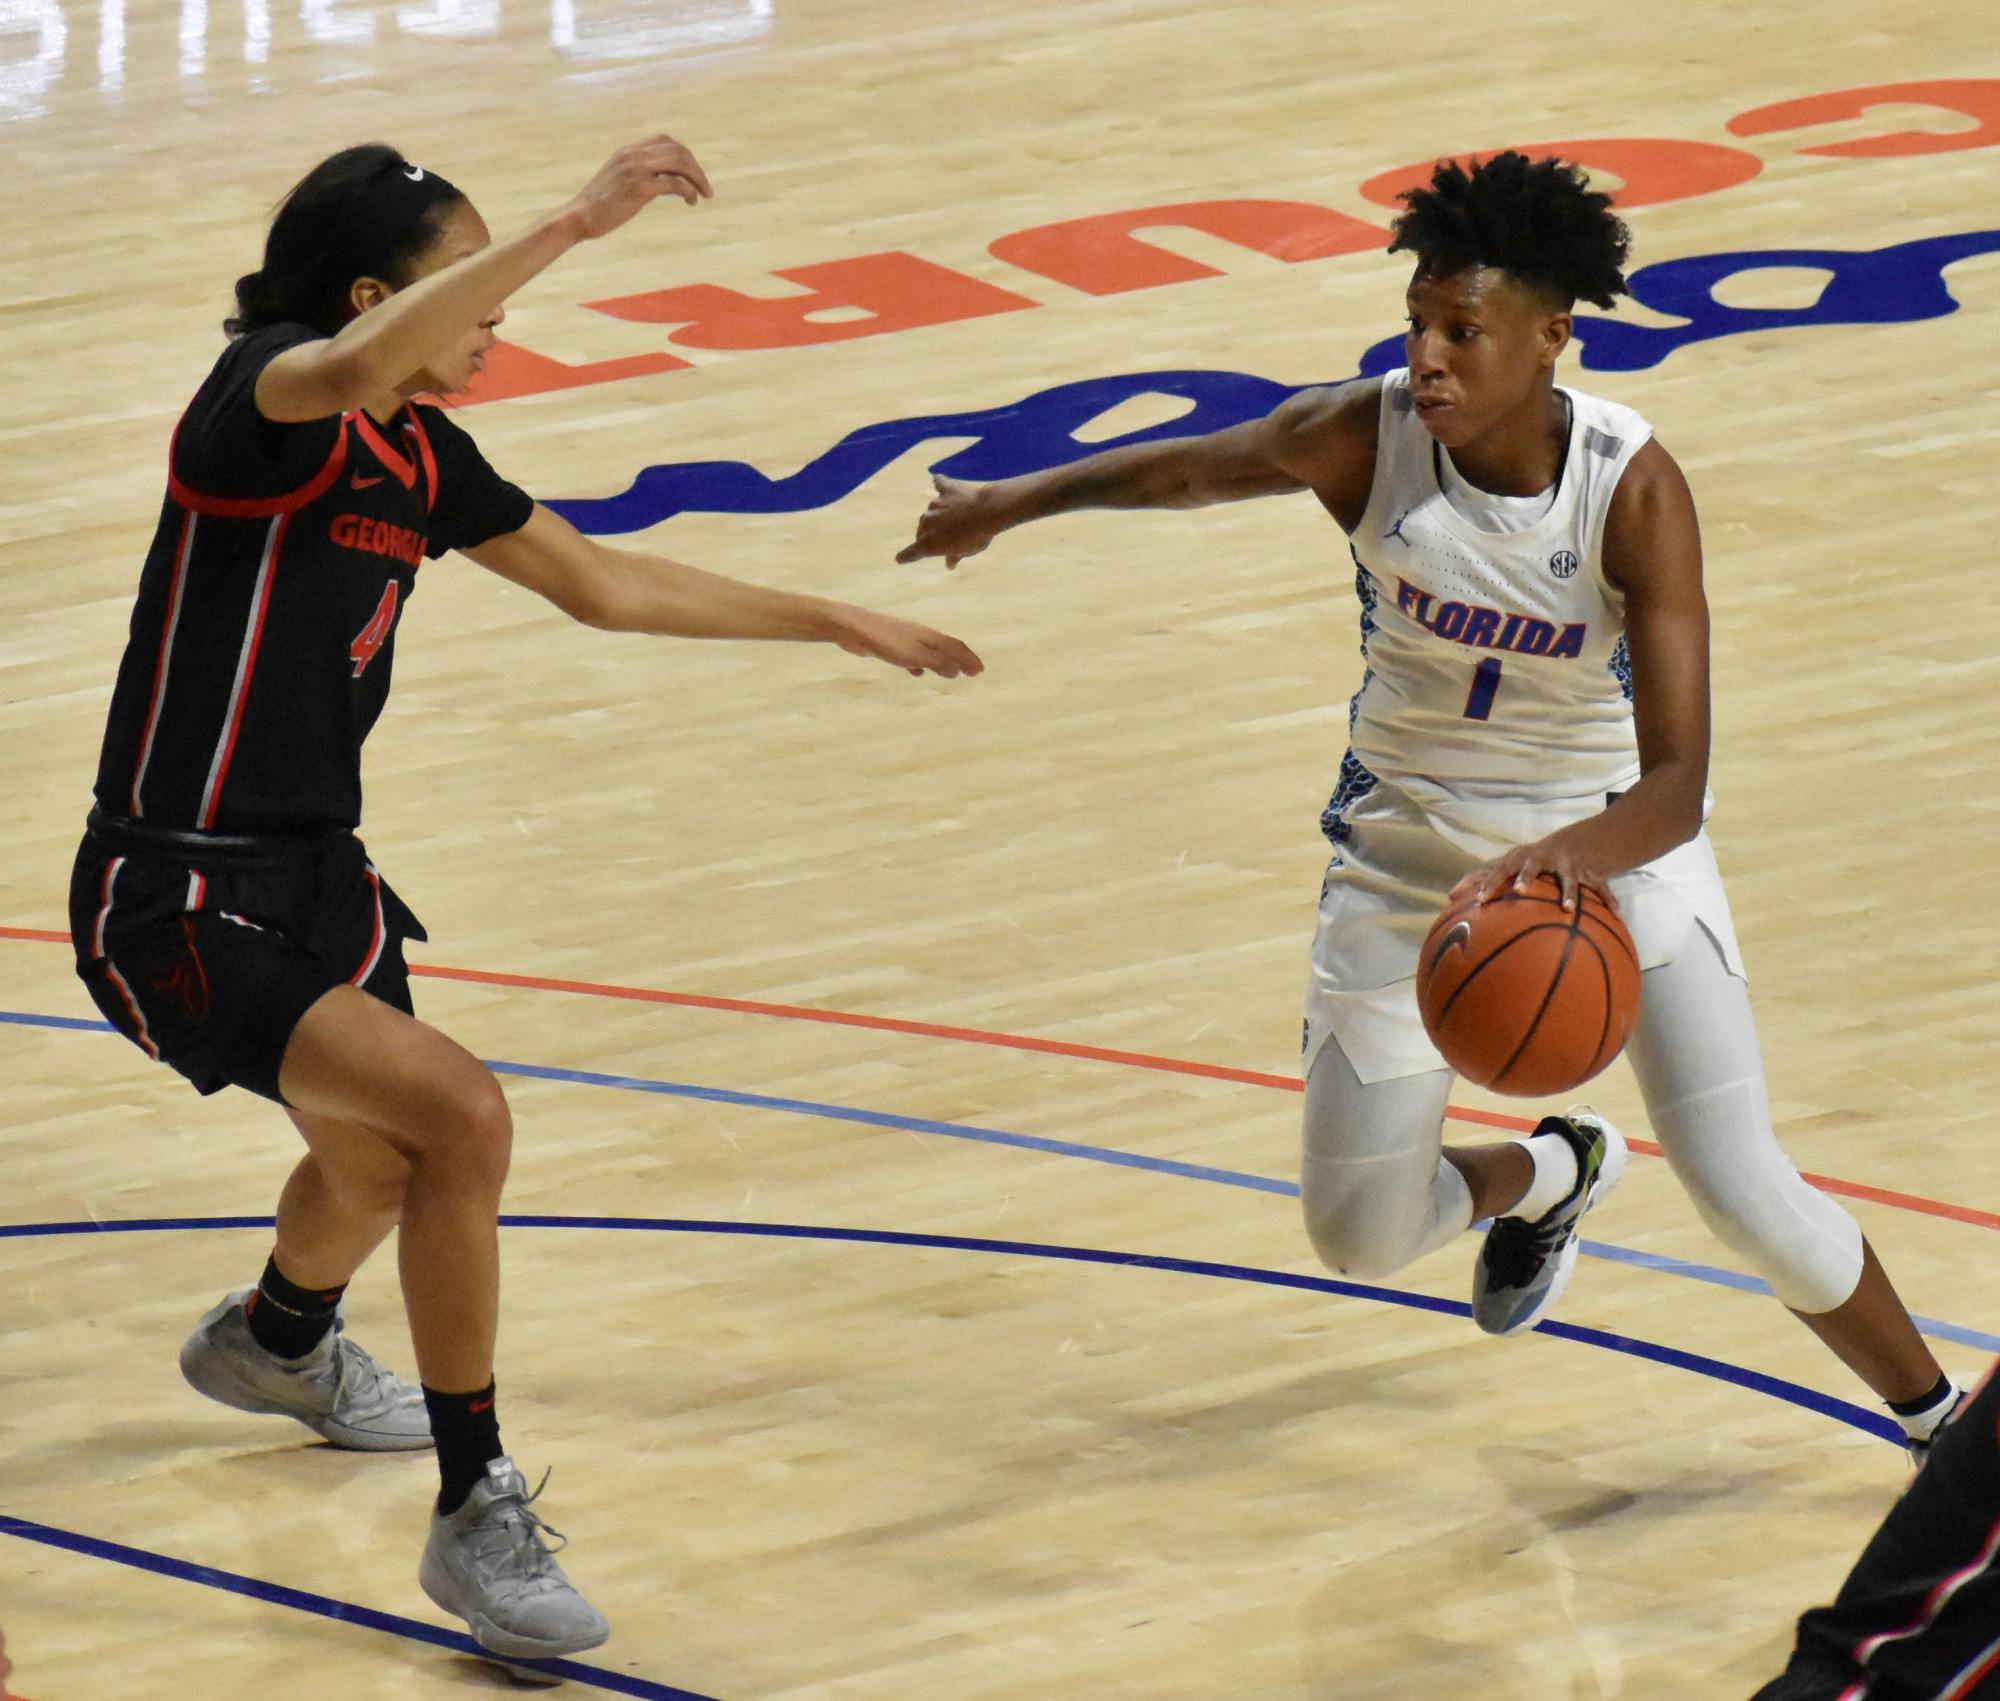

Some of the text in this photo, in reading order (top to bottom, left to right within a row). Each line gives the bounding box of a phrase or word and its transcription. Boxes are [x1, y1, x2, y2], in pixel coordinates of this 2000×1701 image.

[1550, 551, 1577, 578] SEC
[349, 579, 398, 677] 4
[1398, 577, 1587, 659] FLORIDA
[1463, 657, 1503, 720] 1
